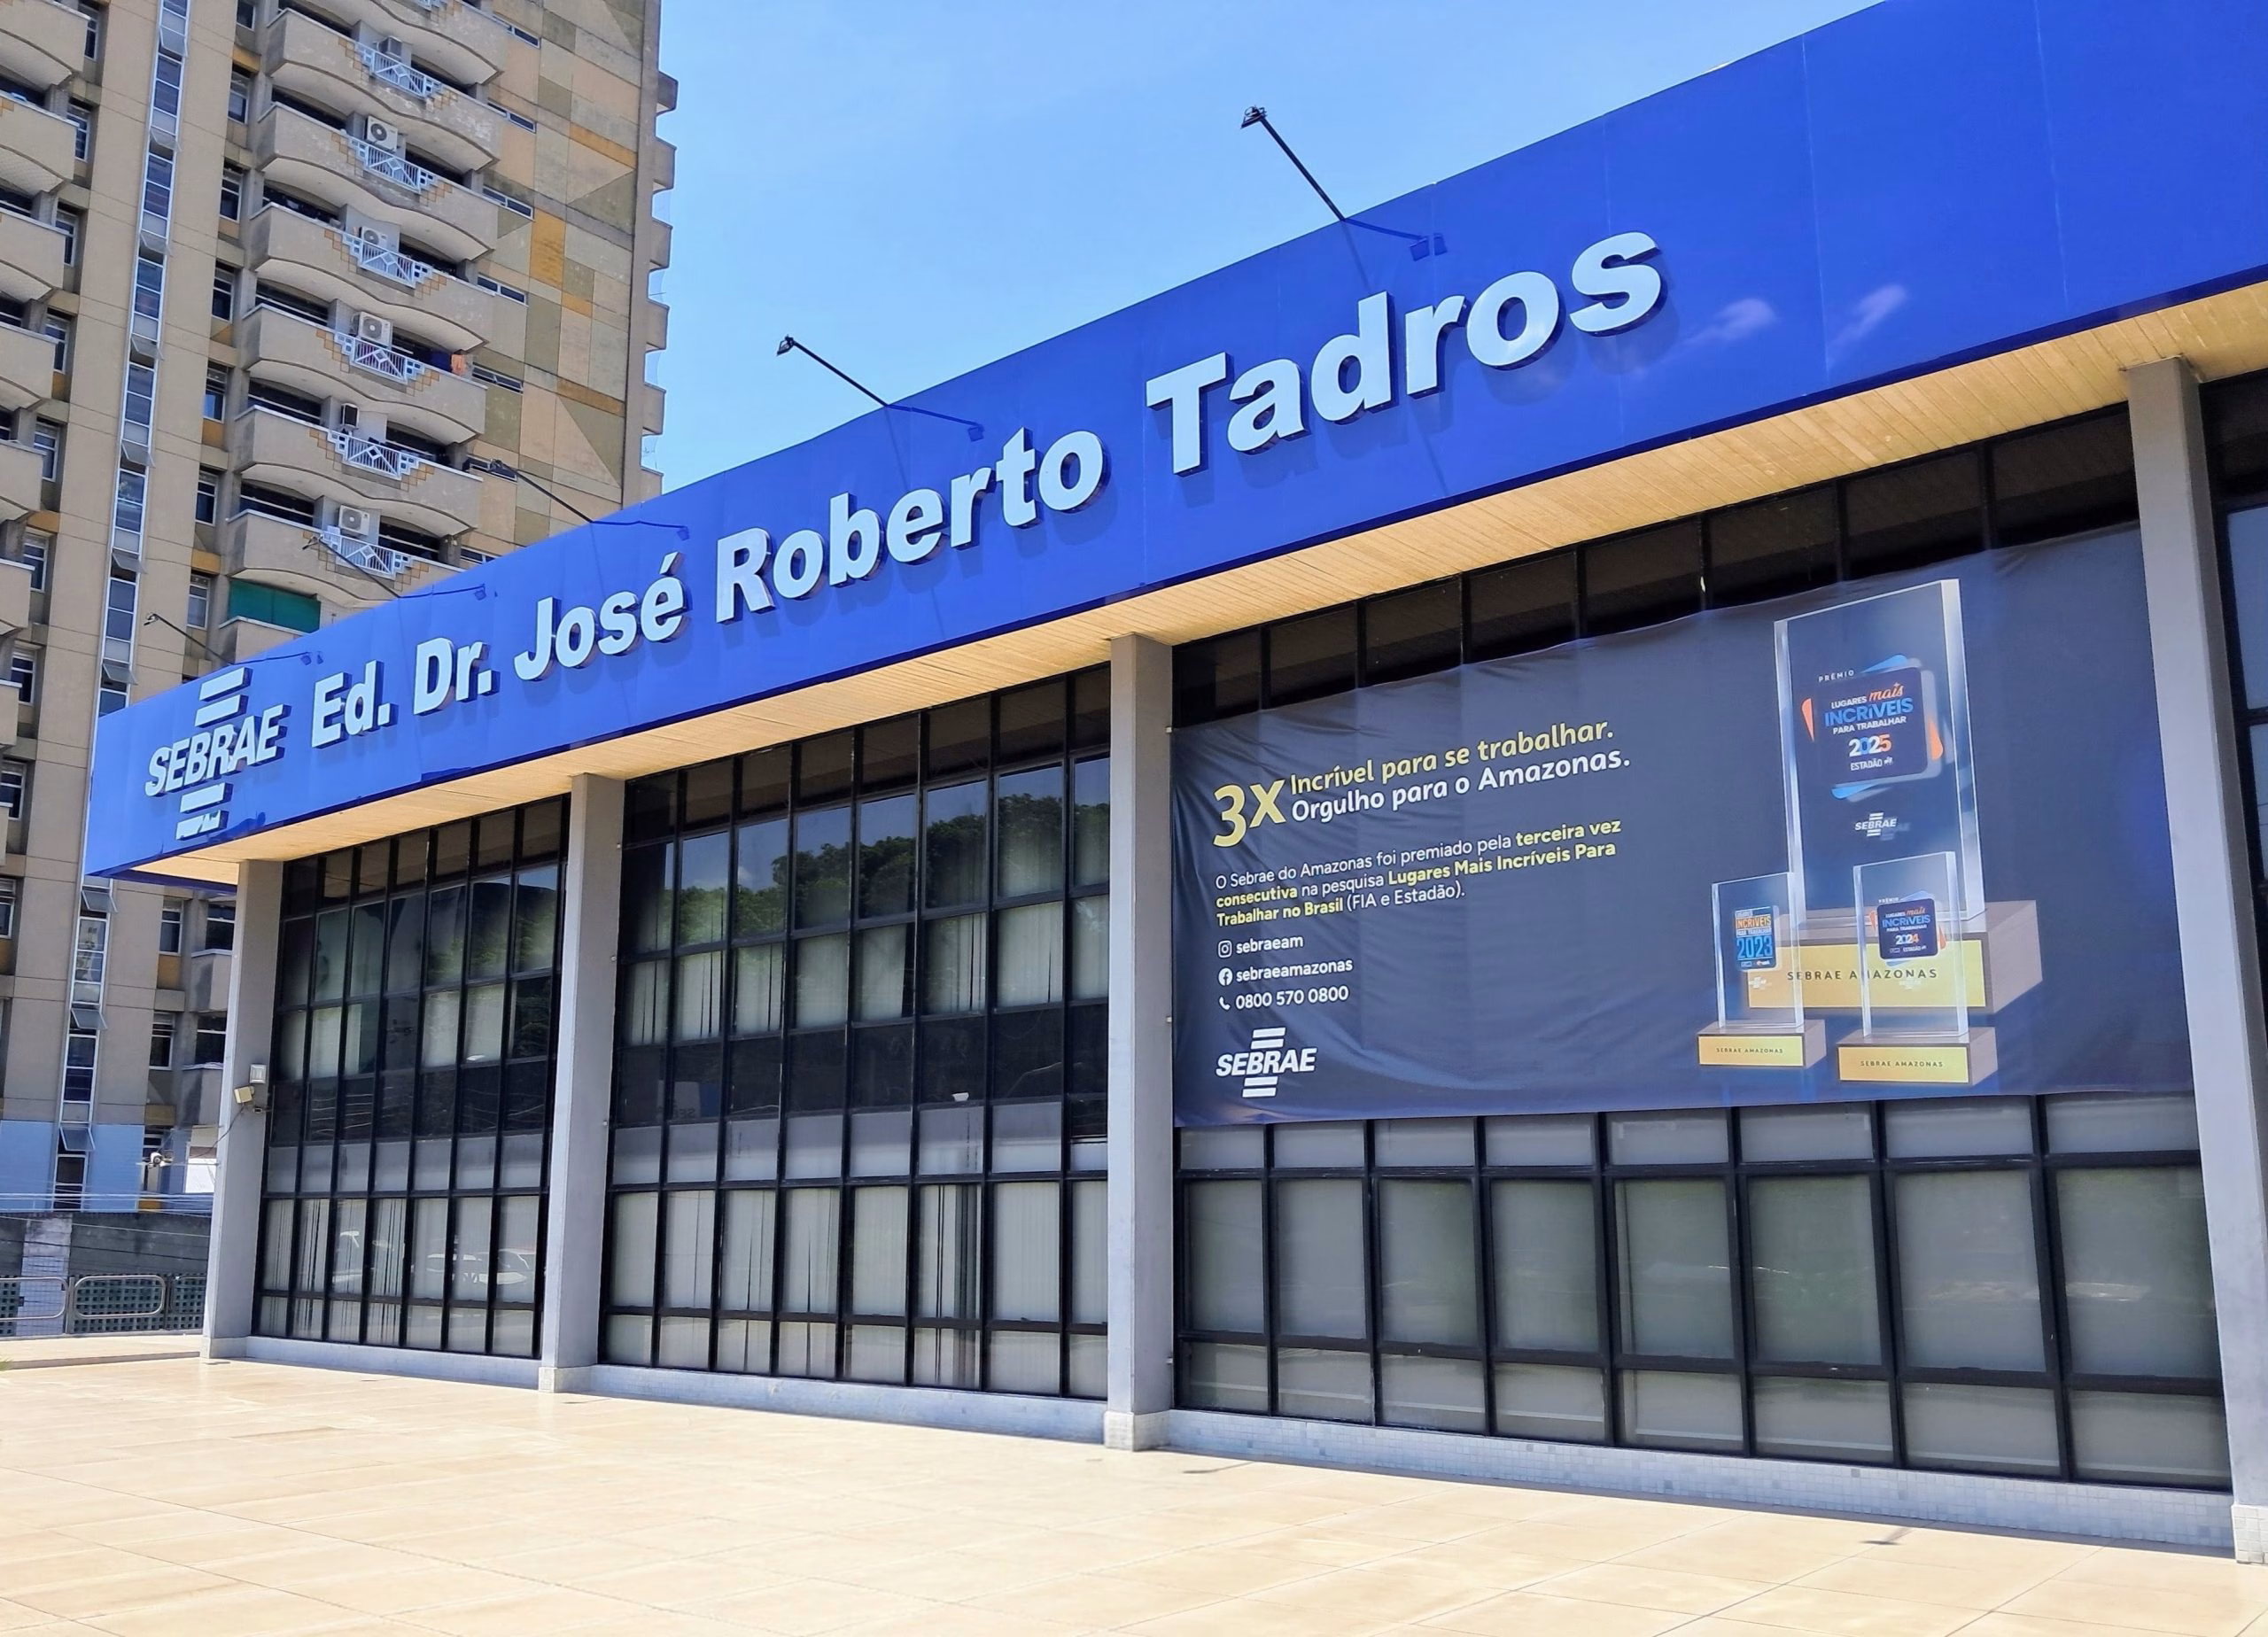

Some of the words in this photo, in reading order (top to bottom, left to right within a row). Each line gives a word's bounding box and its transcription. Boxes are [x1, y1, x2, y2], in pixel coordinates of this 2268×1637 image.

[310, 659, 397, 749] Ed.
[412, 636, 498, 716] Dr.
[514, 551, 687, 682] José
[716, 428, 1111, 623] Roberto
[1145, 229, 1666, 477] Tadros
[1831, 696, 1867, 709] LUGARES
[1868, 682, 1905, 702] mais
[1833, 724, 1855, 734] PARA
[1857, 716, 1907, 731] TRABALHAR
[144, 704, 288, 797] SEBRAE
[1848, 733, 1892, 756] 2025
[1290, 758, 1375, 795] Incrível
[1381, 753, 1437, 784] para
[1444, 748, 1470, 768] se
[1477, 721, 1613, 761] trabalhar.
[1850, 757, 1883, 771] ESTADÃO
[1291, 788, 1385, 823] Orgulho
[1392, 780, 1448, 811] para
[1455, 777, 1470, 794] o
[1478, 750, 1630, 791] Amazonas.
[1213, 780, 1286, 848] 3X
[1854, 818, 1897, 831] SEBRAE
[1216, 875, 1227, 889] O
[1231, 869, 1275, 888] Sebrae
[1278, 865, 1297, 881] do
[1300, 856, 1372, 878] Amazonas
[1376, 850, 1396, 866] foi
[1401, 840, 1472, 867] premiado
[1477, 834, 1511, 856] pela
[1515, 824, 1585, 848] terceira
[1588, 819, 1622, 835] vez
[1216, 886, 1298, 909] consecutiva
[1301, 886, 1318, 897] na
[1321, 874, 1384, 897] pesquisa
[1387, 866, 1450, 887] Lugares
[1454, 857, 1493, 876] Mais
[1497, 847, 1571, 871] Incríveis
[1575, 842, 1617, 860] Para
[1216, 907, 1279, 927] Trabalhar
[1282, 906, 1301, 919] no
[1304, 897, 1344, 916] Brasil
[1347, 893, 1377, 912] (FIA
[1380, 896, 1390, 906] e
[1394, 880, 1465, 905] Estadão).
[1236, 936, 1304, 954] sebraeam
[1736, 935, 1773, 960] 2023
[1895, 934, 1919, 945] 2024
[1236, 959, 1354, 982] sebraeamazonas
[1787, 970, 1842, 981] SEBRAE
[1235, 992, 1272, 1010] 0800
[1276, 989, 1305, 1006] 570
[1308, 985, 1349, 1003] 0800
[1216, 1047, 1317, 1076] SEBRAE
